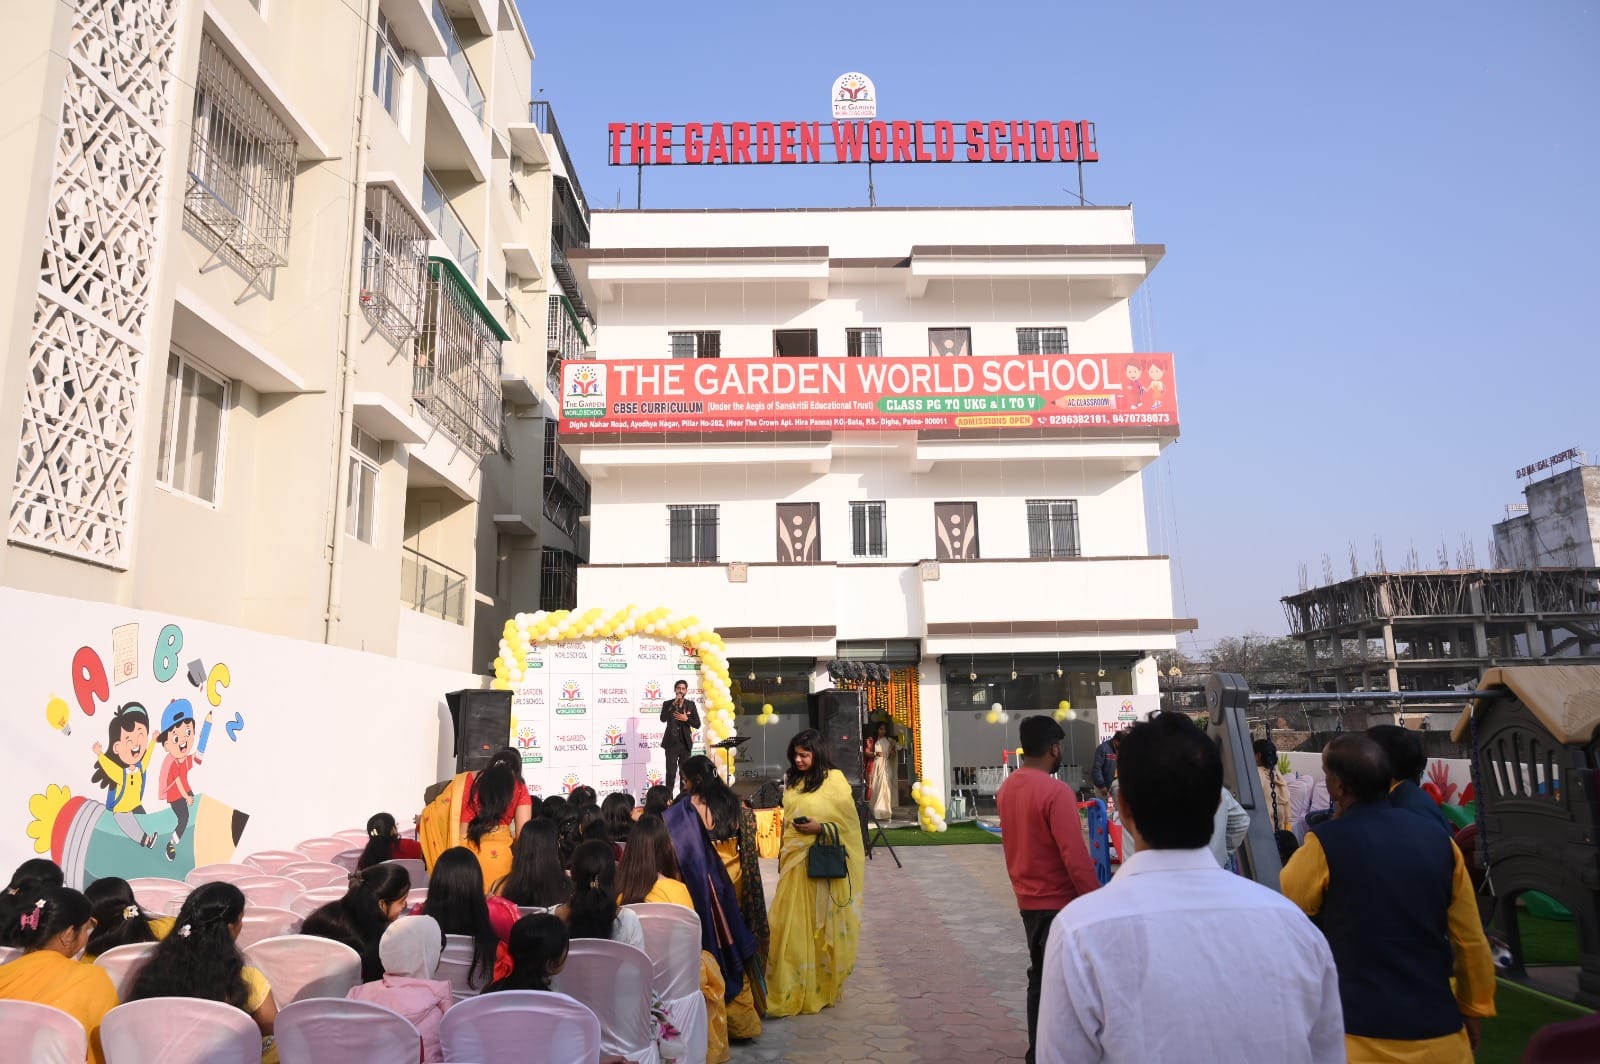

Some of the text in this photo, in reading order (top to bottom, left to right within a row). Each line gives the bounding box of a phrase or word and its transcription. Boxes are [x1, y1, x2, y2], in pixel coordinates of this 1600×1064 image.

[608, 119, 1098, 164] THE GARDEN WORLD SCHOOL
[613, 358, 1122, 396] THE GARDEN WORLD SCHOOL
[578, 400, 605, 408] GARDEN
[613, 402, 638, 414] CBSE
[640, 402, 704, 413] CURRICULUM
[732, 400, 745, 410] the
[767, 400, 774, 410] of
[810, 400, 851, 410] Educational
[886, 397, 1036, 410] CLASS PG TO UKG & I TO V
[1076, 397, 1110, 406] CLASSROOM
[745, 418, 757, 426] The
[759, 418, 779, 426] Crown
[958, 415, 1031, 426] ADMISSIONS OPEN
[72, 646, 109, 716] A
[153, 624, 183, 683] B
[207, 663, 230, 707] C
[1103, 722, 1118, 732] THE
